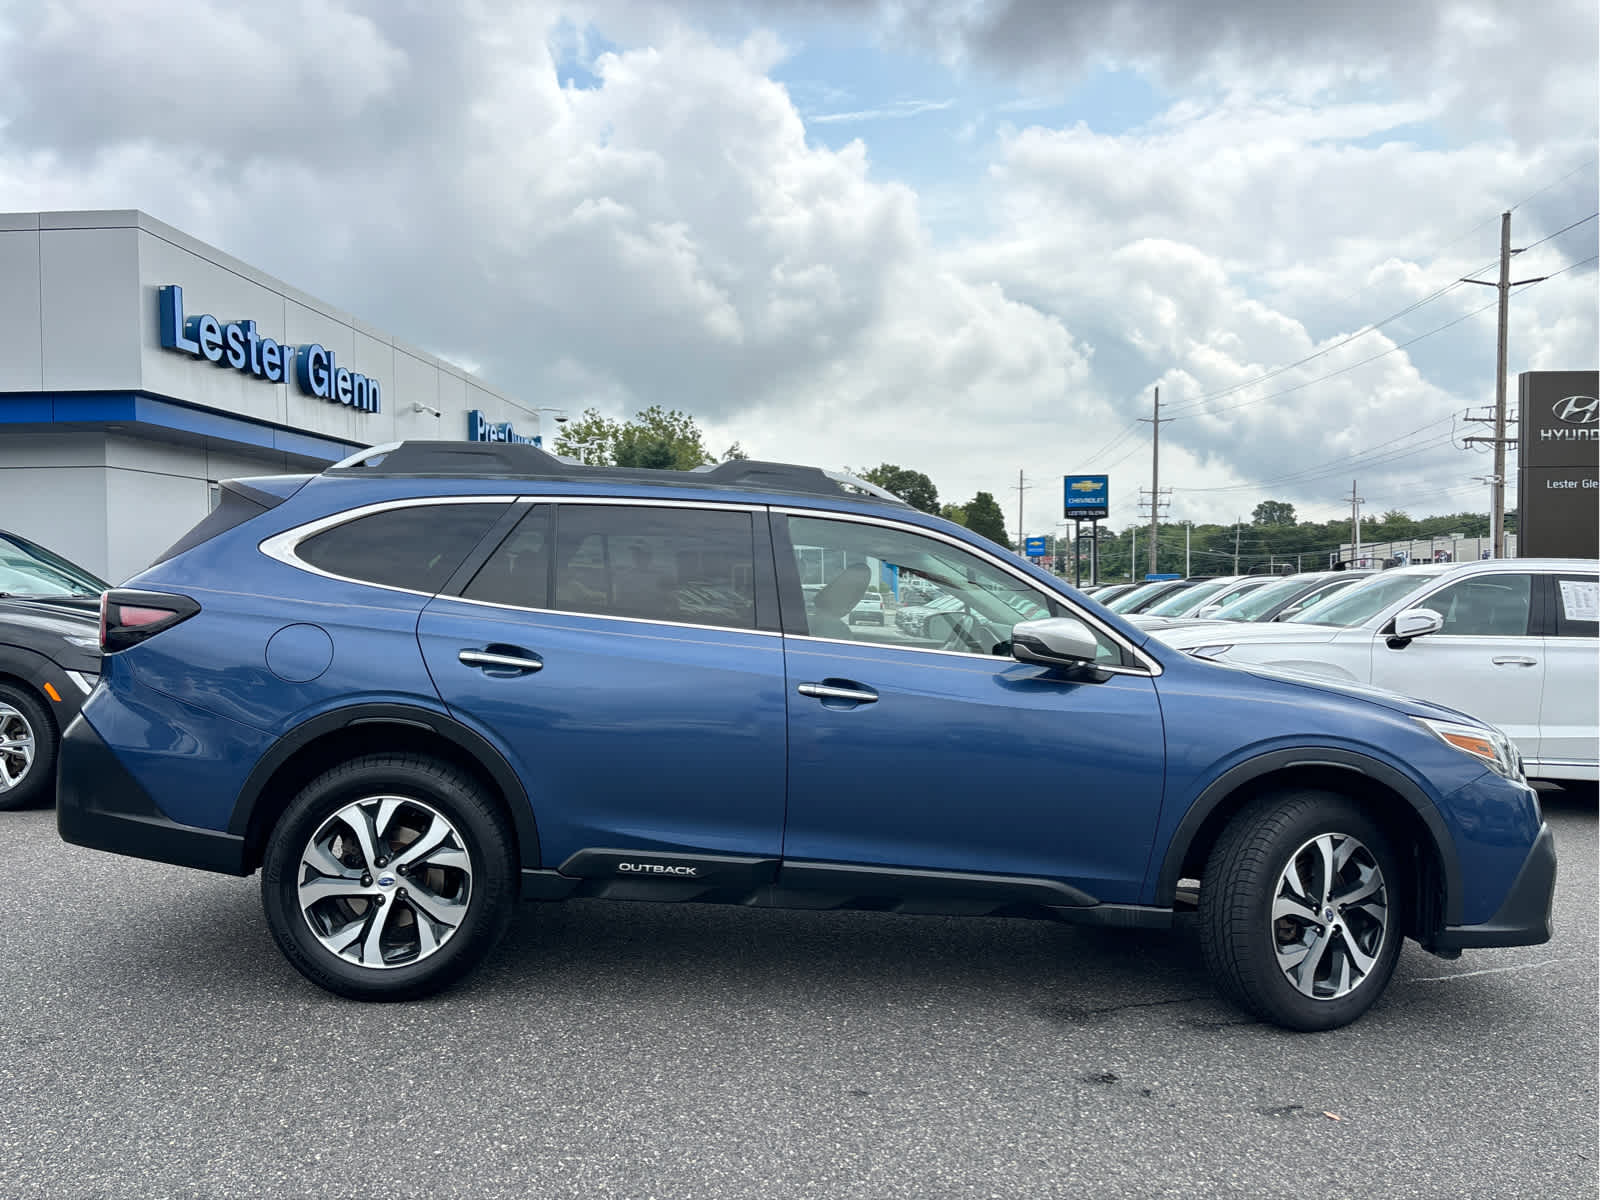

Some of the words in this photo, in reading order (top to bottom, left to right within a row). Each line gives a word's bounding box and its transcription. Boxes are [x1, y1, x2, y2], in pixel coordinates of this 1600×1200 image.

[159, 285, 294, 384] Lester
[297, 344, 381, 413] Glenn
[1546, 479, 1578, 488] Lester
[619, 863, 696, 875] OUTBACK
